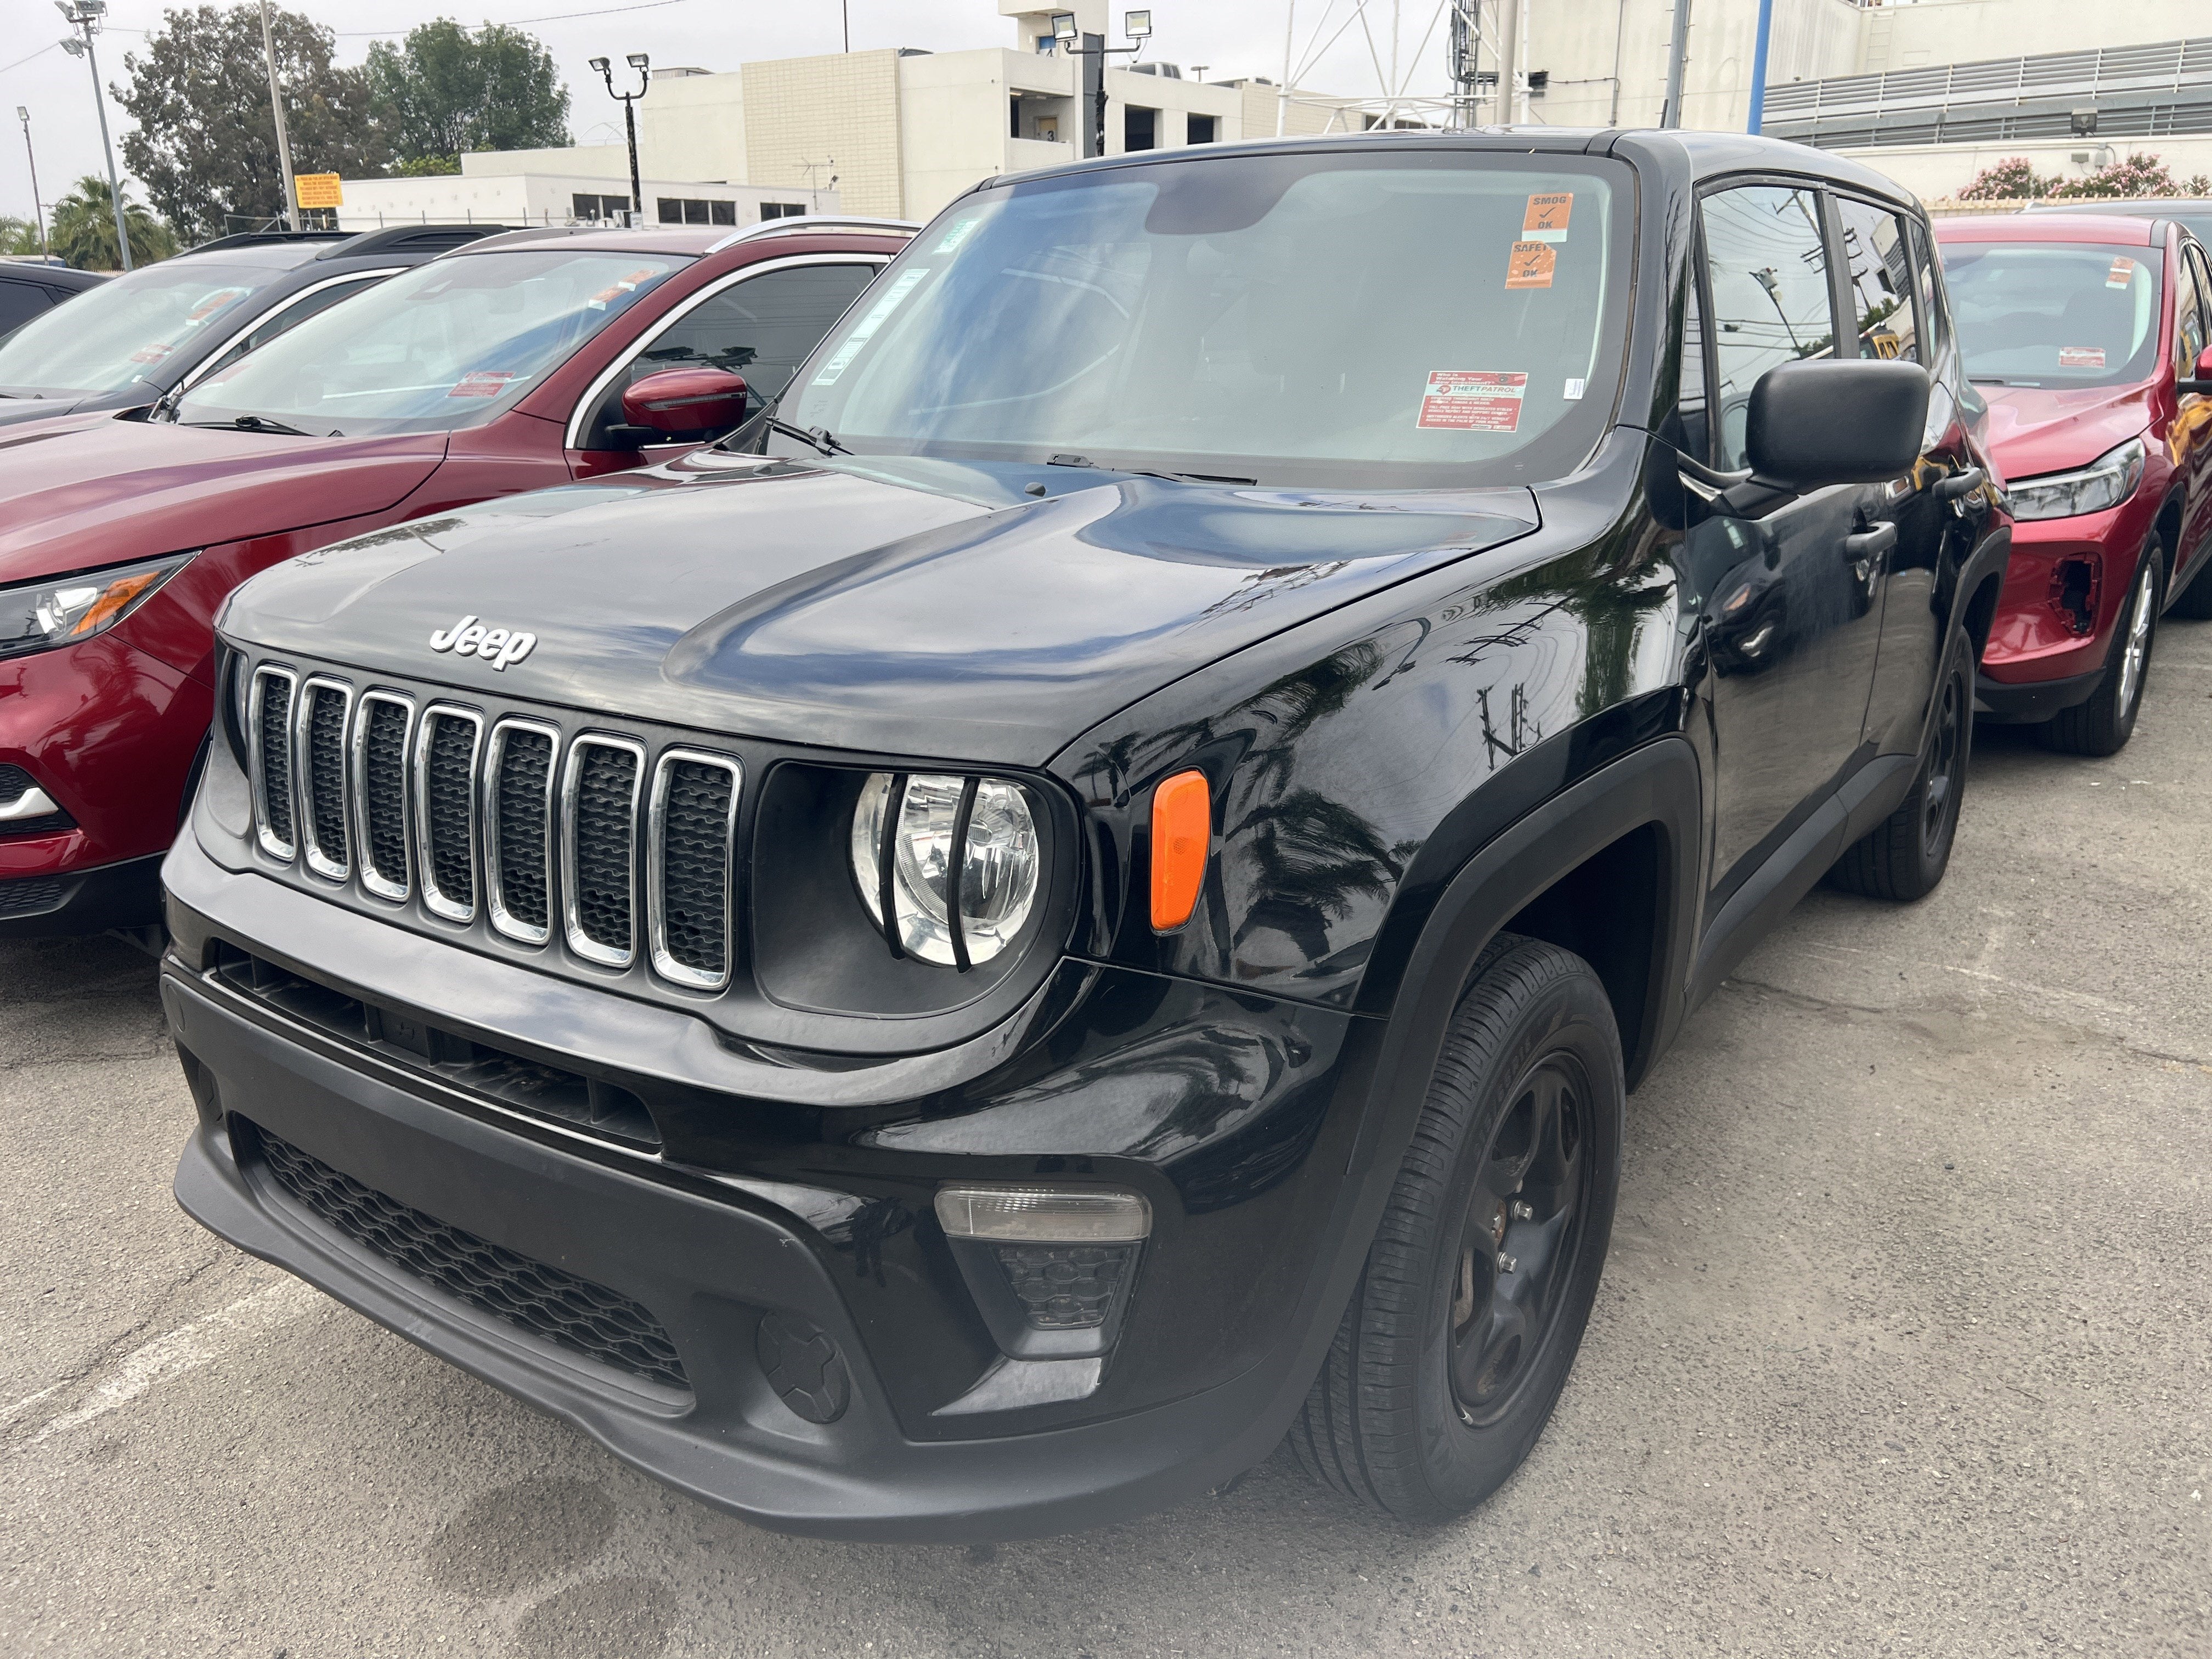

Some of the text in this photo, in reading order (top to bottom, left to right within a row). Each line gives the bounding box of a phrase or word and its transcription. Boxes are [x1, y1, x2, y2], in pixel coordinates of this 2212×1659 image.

[1047, 130, 1054, 142] 3
[1533, 196, 1566, 205] SMOG
[1538, 221, 1553, 229] OK
[1522, 269, 1538, 278] OK
[430, 615, 538, 672] Jeep
